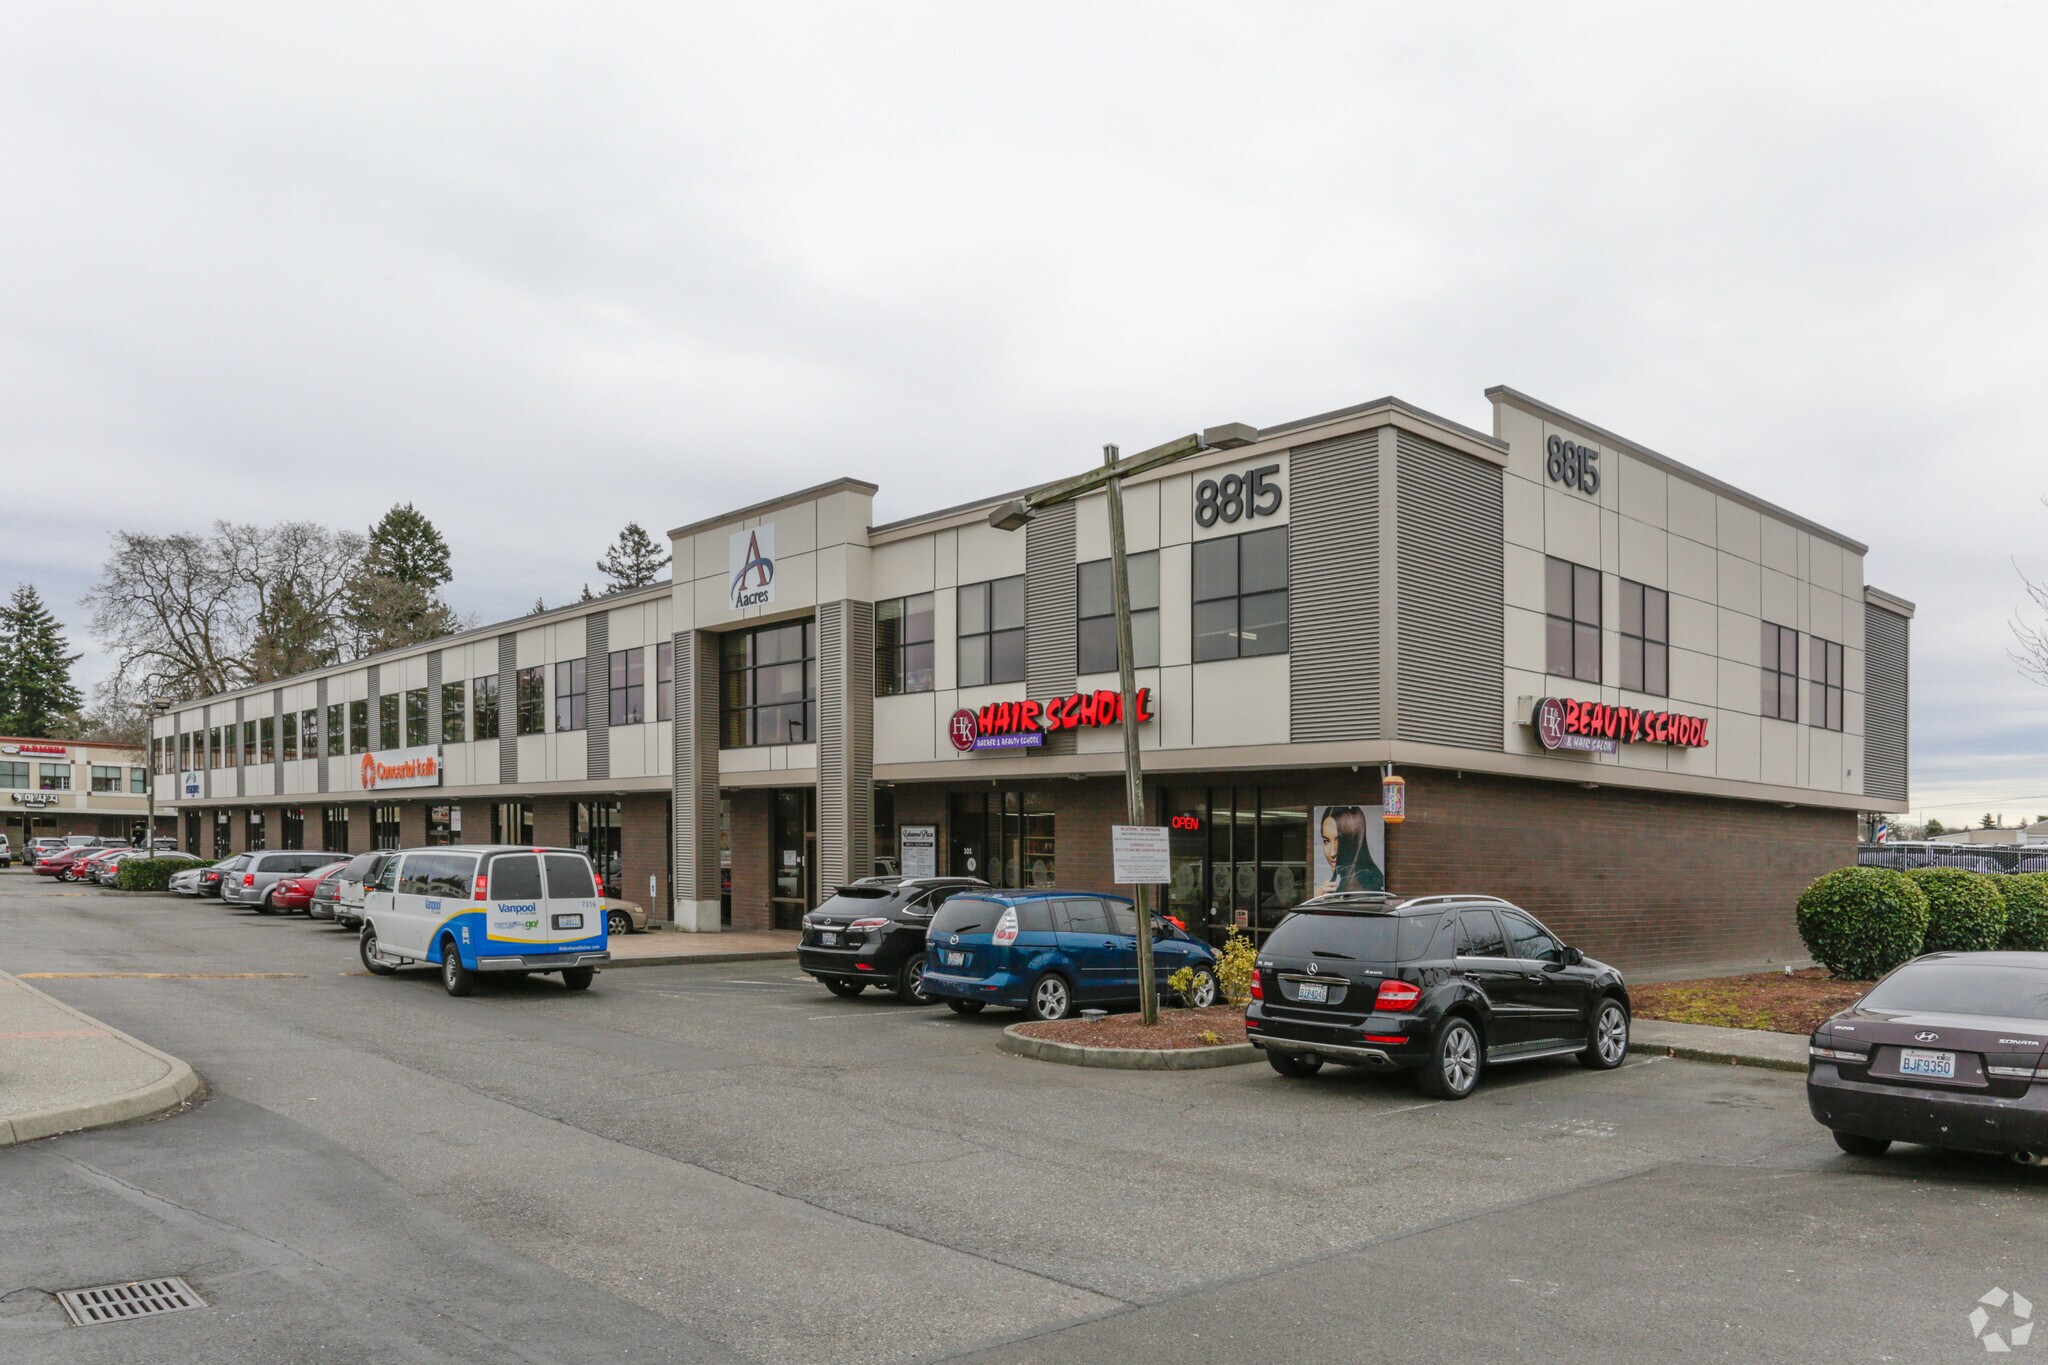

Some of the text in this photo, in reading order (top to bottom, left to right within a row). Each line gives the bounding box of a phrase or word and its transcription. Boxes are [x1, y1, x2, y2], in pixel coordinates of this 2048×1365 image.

[1546, 434, 1600, 495] 8815
[1195, 464, 1282, 528] 8815
[735, 591, 769, 608] Aacres
[978, 699, 1042, 735] HAIR
[1566, 697, 1709, 747] BEAUTY SCHOOL
[1001, 736, 1019, 746] BEAUTY
[1020, 735, 1040, 745] SCHOOL
[1573, 737, 1590, 749] HAIR
[1591, 740, 1613, 751] SALON
[20, 745, 66, 754] FARMERS
[24, 793, 59, 804] 마사지
[1171, 816, 1199, 830] OPEN
[498, 902, 536, 915] Vanpool
[525, 919, 539, 931] go!
[1998, 1038, 2040, 1046] SONATA
[1903, 1057, 1951, 1074] BJF9350
